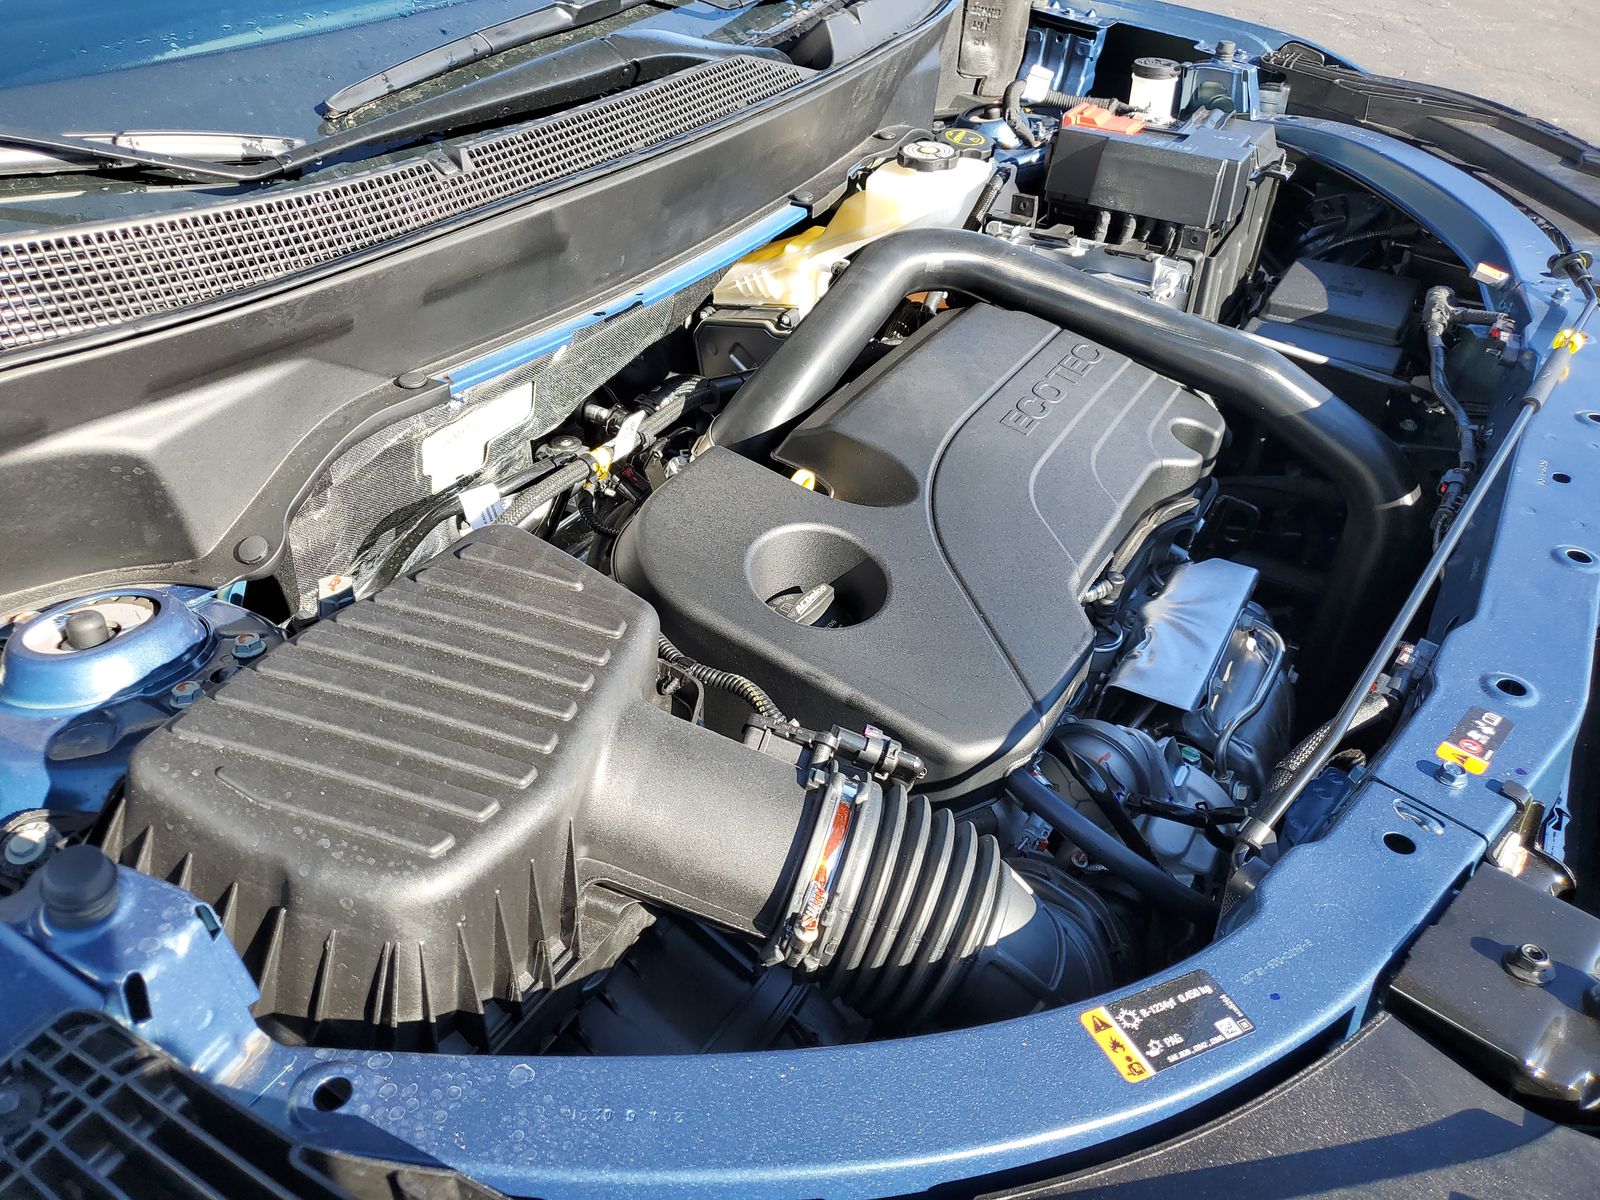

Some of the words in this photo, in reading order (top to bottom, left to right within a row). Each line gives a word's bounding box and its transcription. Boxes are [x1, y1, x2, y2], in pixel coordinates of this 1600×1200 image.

[999, 344, 1104, 436] ECOTEC
[795, 585, 827, 614] ACDelco
[1199, 985, 1213, 996] kg
[1163, 1033, 1184, 1047] PAG
